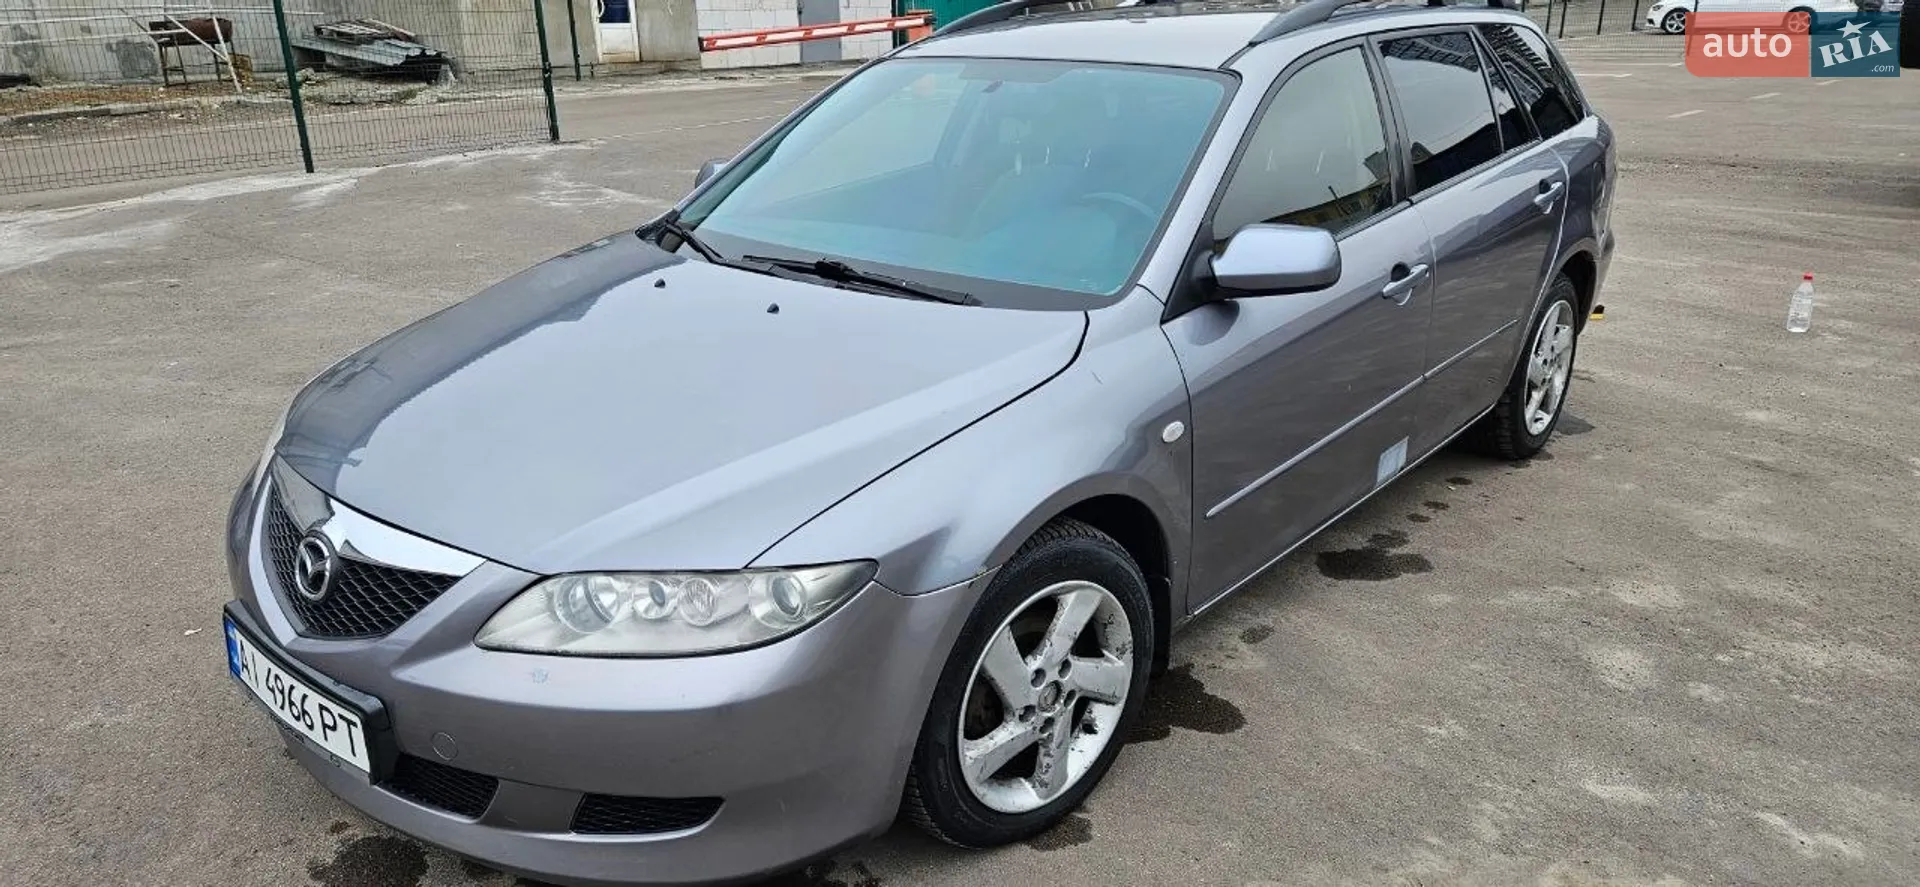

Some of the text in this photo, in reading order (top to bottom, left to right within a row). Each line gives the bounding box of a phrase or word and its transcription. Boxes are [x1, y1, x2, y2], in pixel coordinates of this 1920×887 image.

[240, 639, 259, 689] AI
[266, 667, 314, 731] 4966
[318, 703, 358, 757] PT
